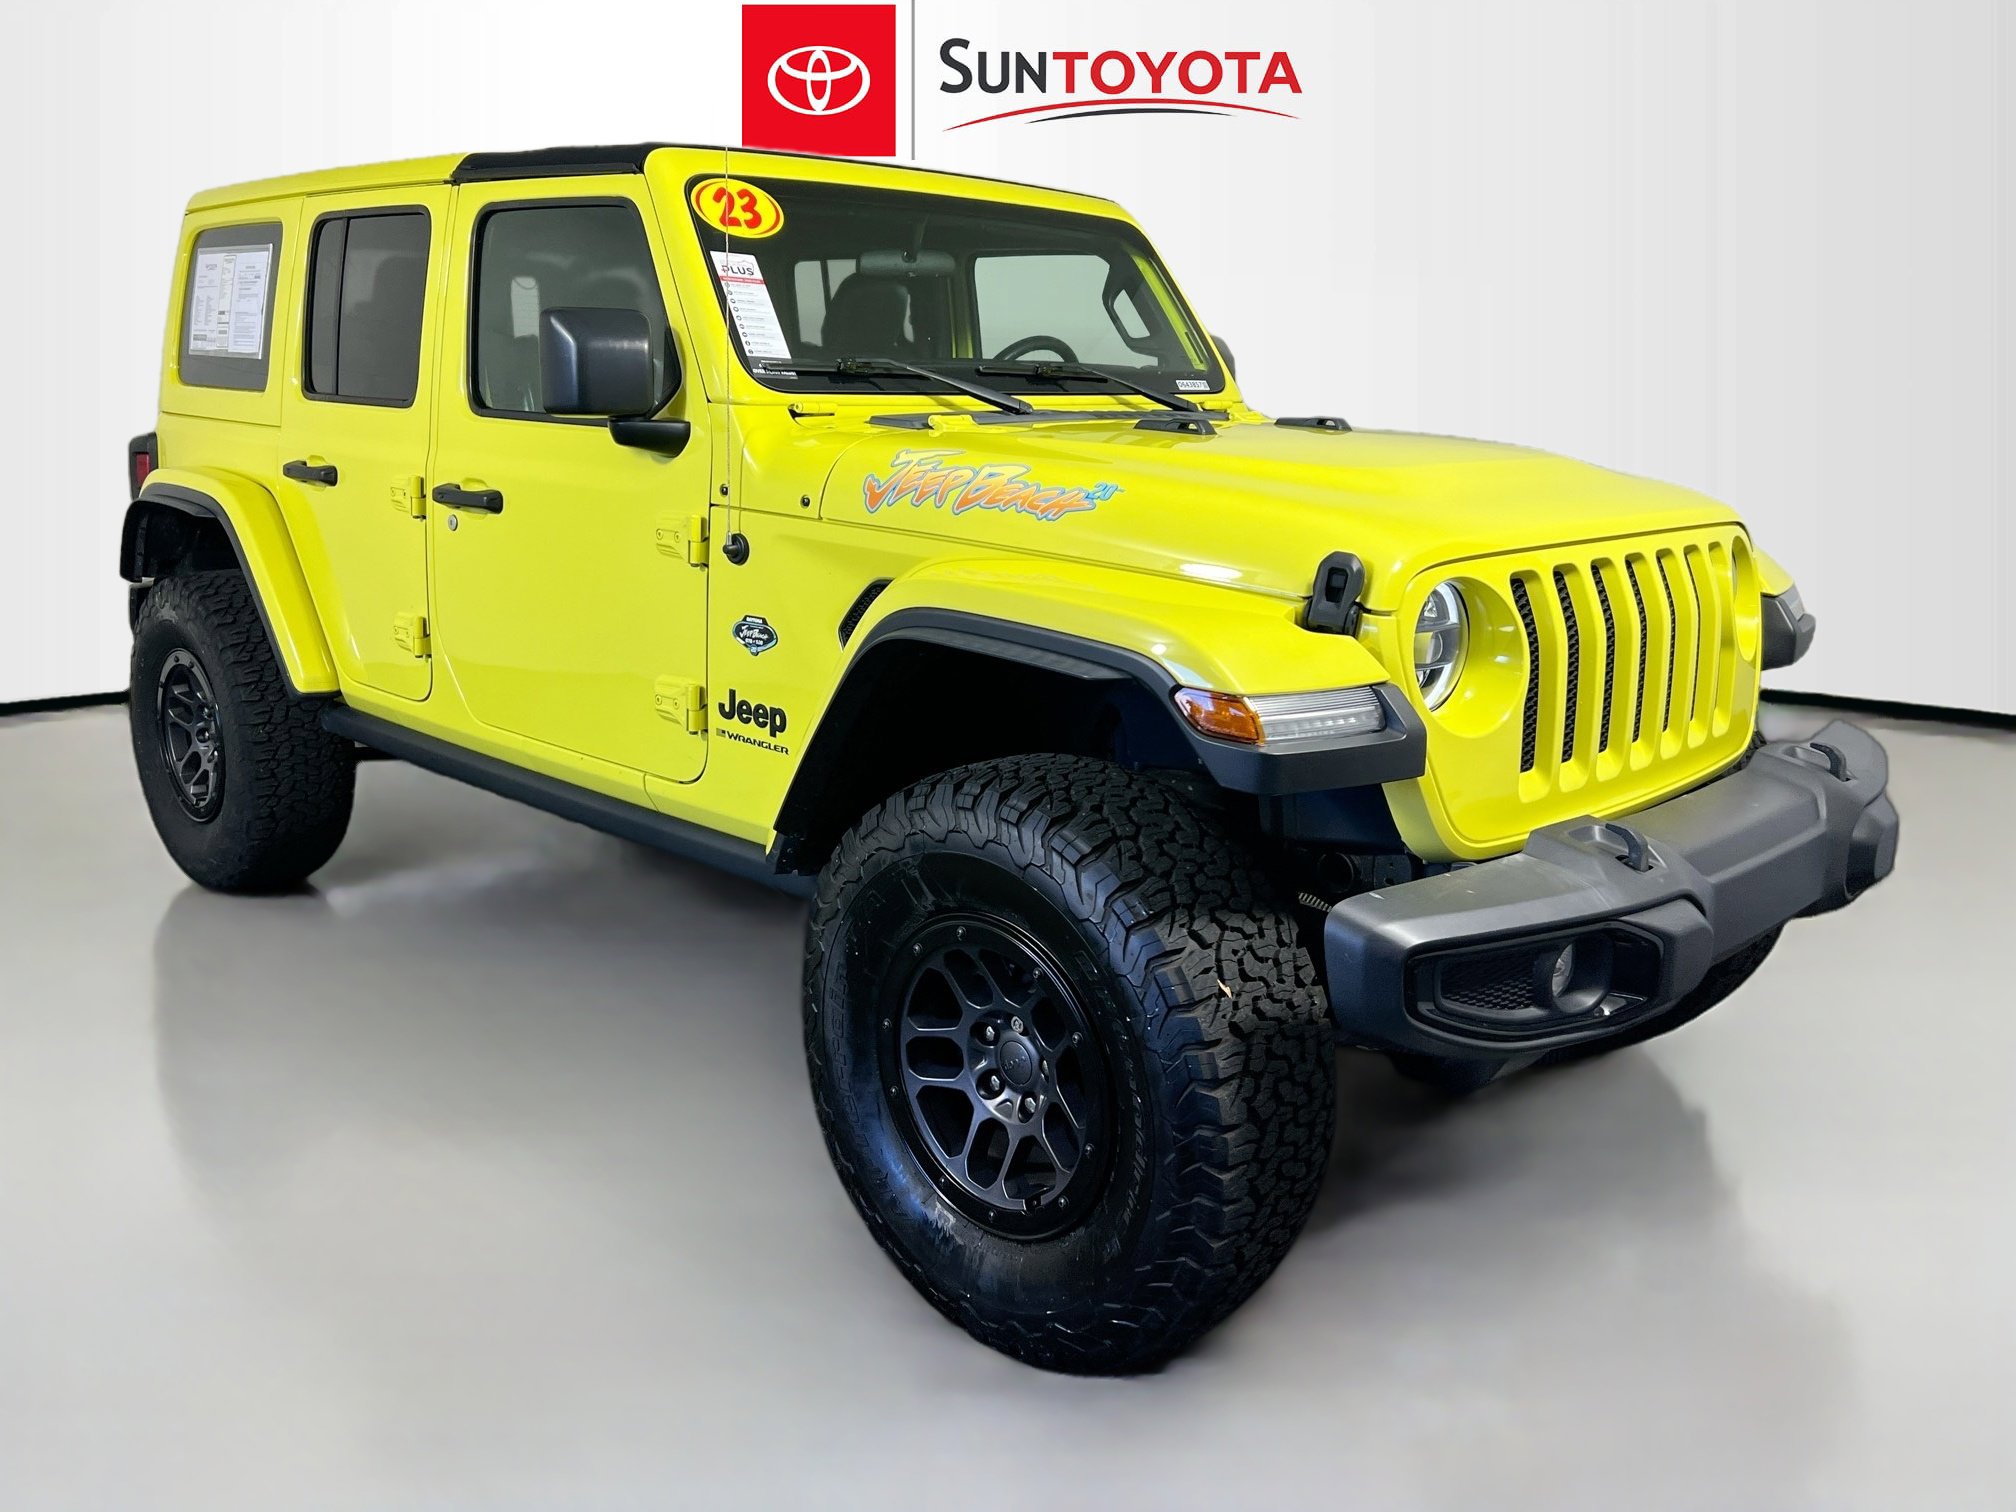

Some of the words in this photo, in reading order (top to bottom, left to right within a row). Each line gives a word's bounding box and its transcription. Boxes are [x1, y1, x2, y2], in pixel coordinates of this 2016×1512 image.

[713, 187, 762, 229] 23
[718, 688, 787, 738] Jeep
[727, 731, 789, 755] WRANGLER
